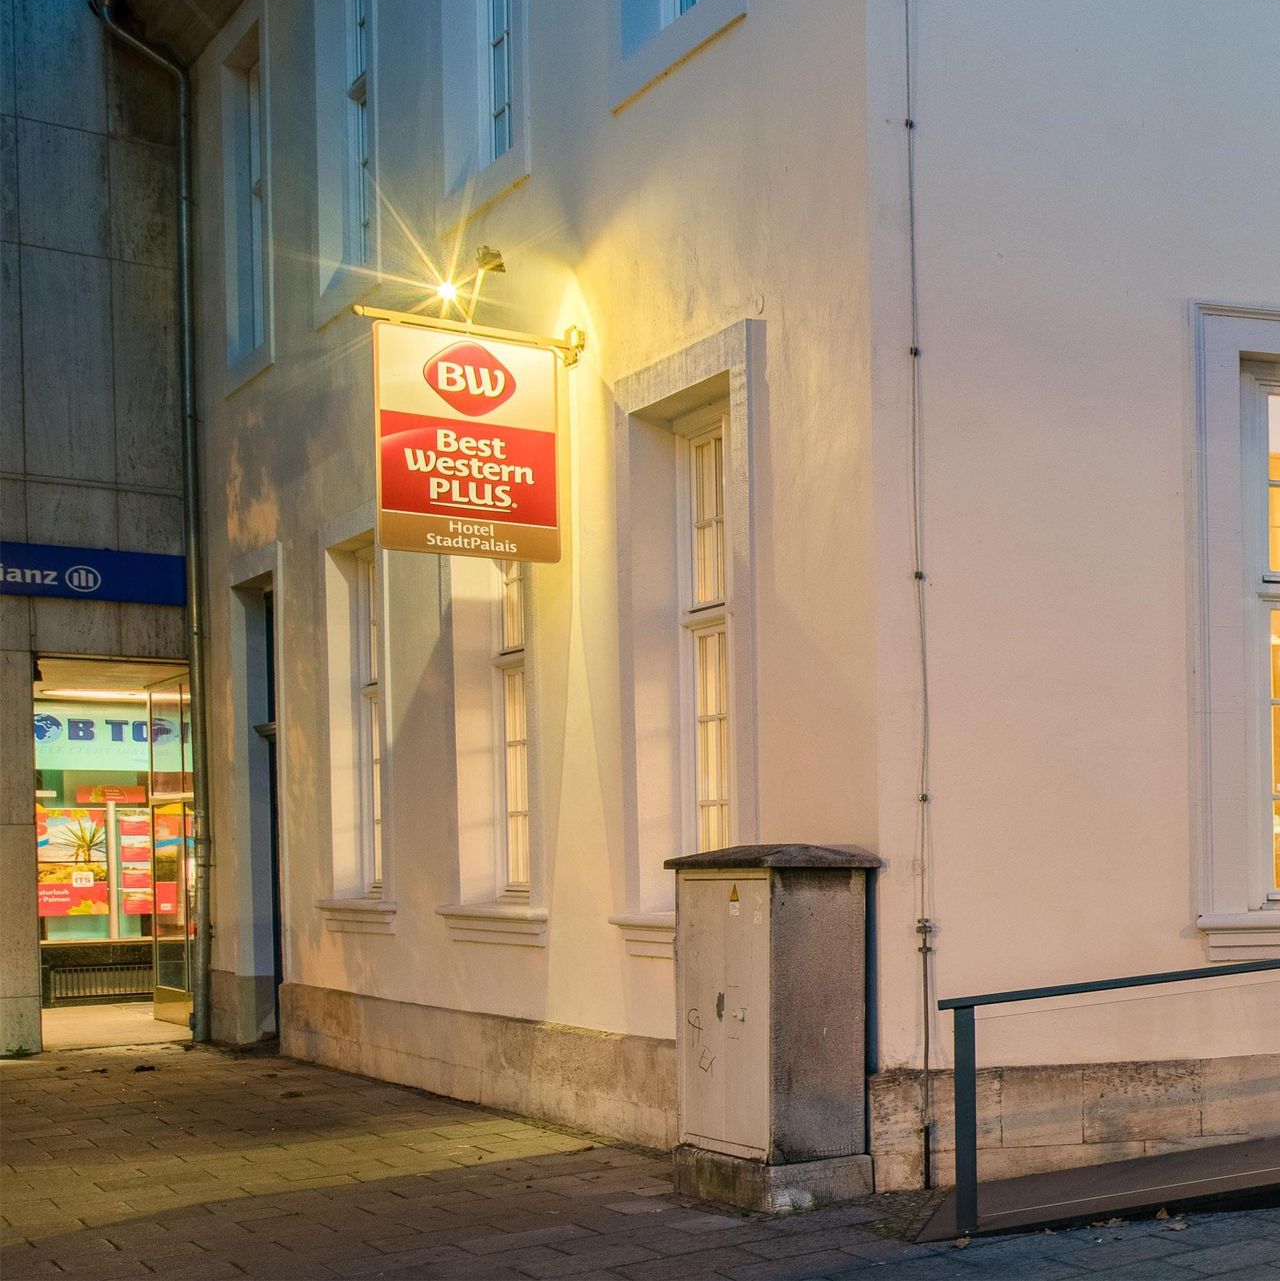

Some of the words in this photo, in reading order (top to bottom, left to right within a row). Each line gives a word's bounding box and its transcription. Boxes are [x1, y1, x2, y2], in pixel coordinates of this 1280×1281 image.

[436, 360, 506, 398] BW
[436, 428, 507, 460] Best
[403, 447, 536, 486] Western
[425, 532, 518, 554] StadtPalais
[449, 520, 495, 537] Hotel
